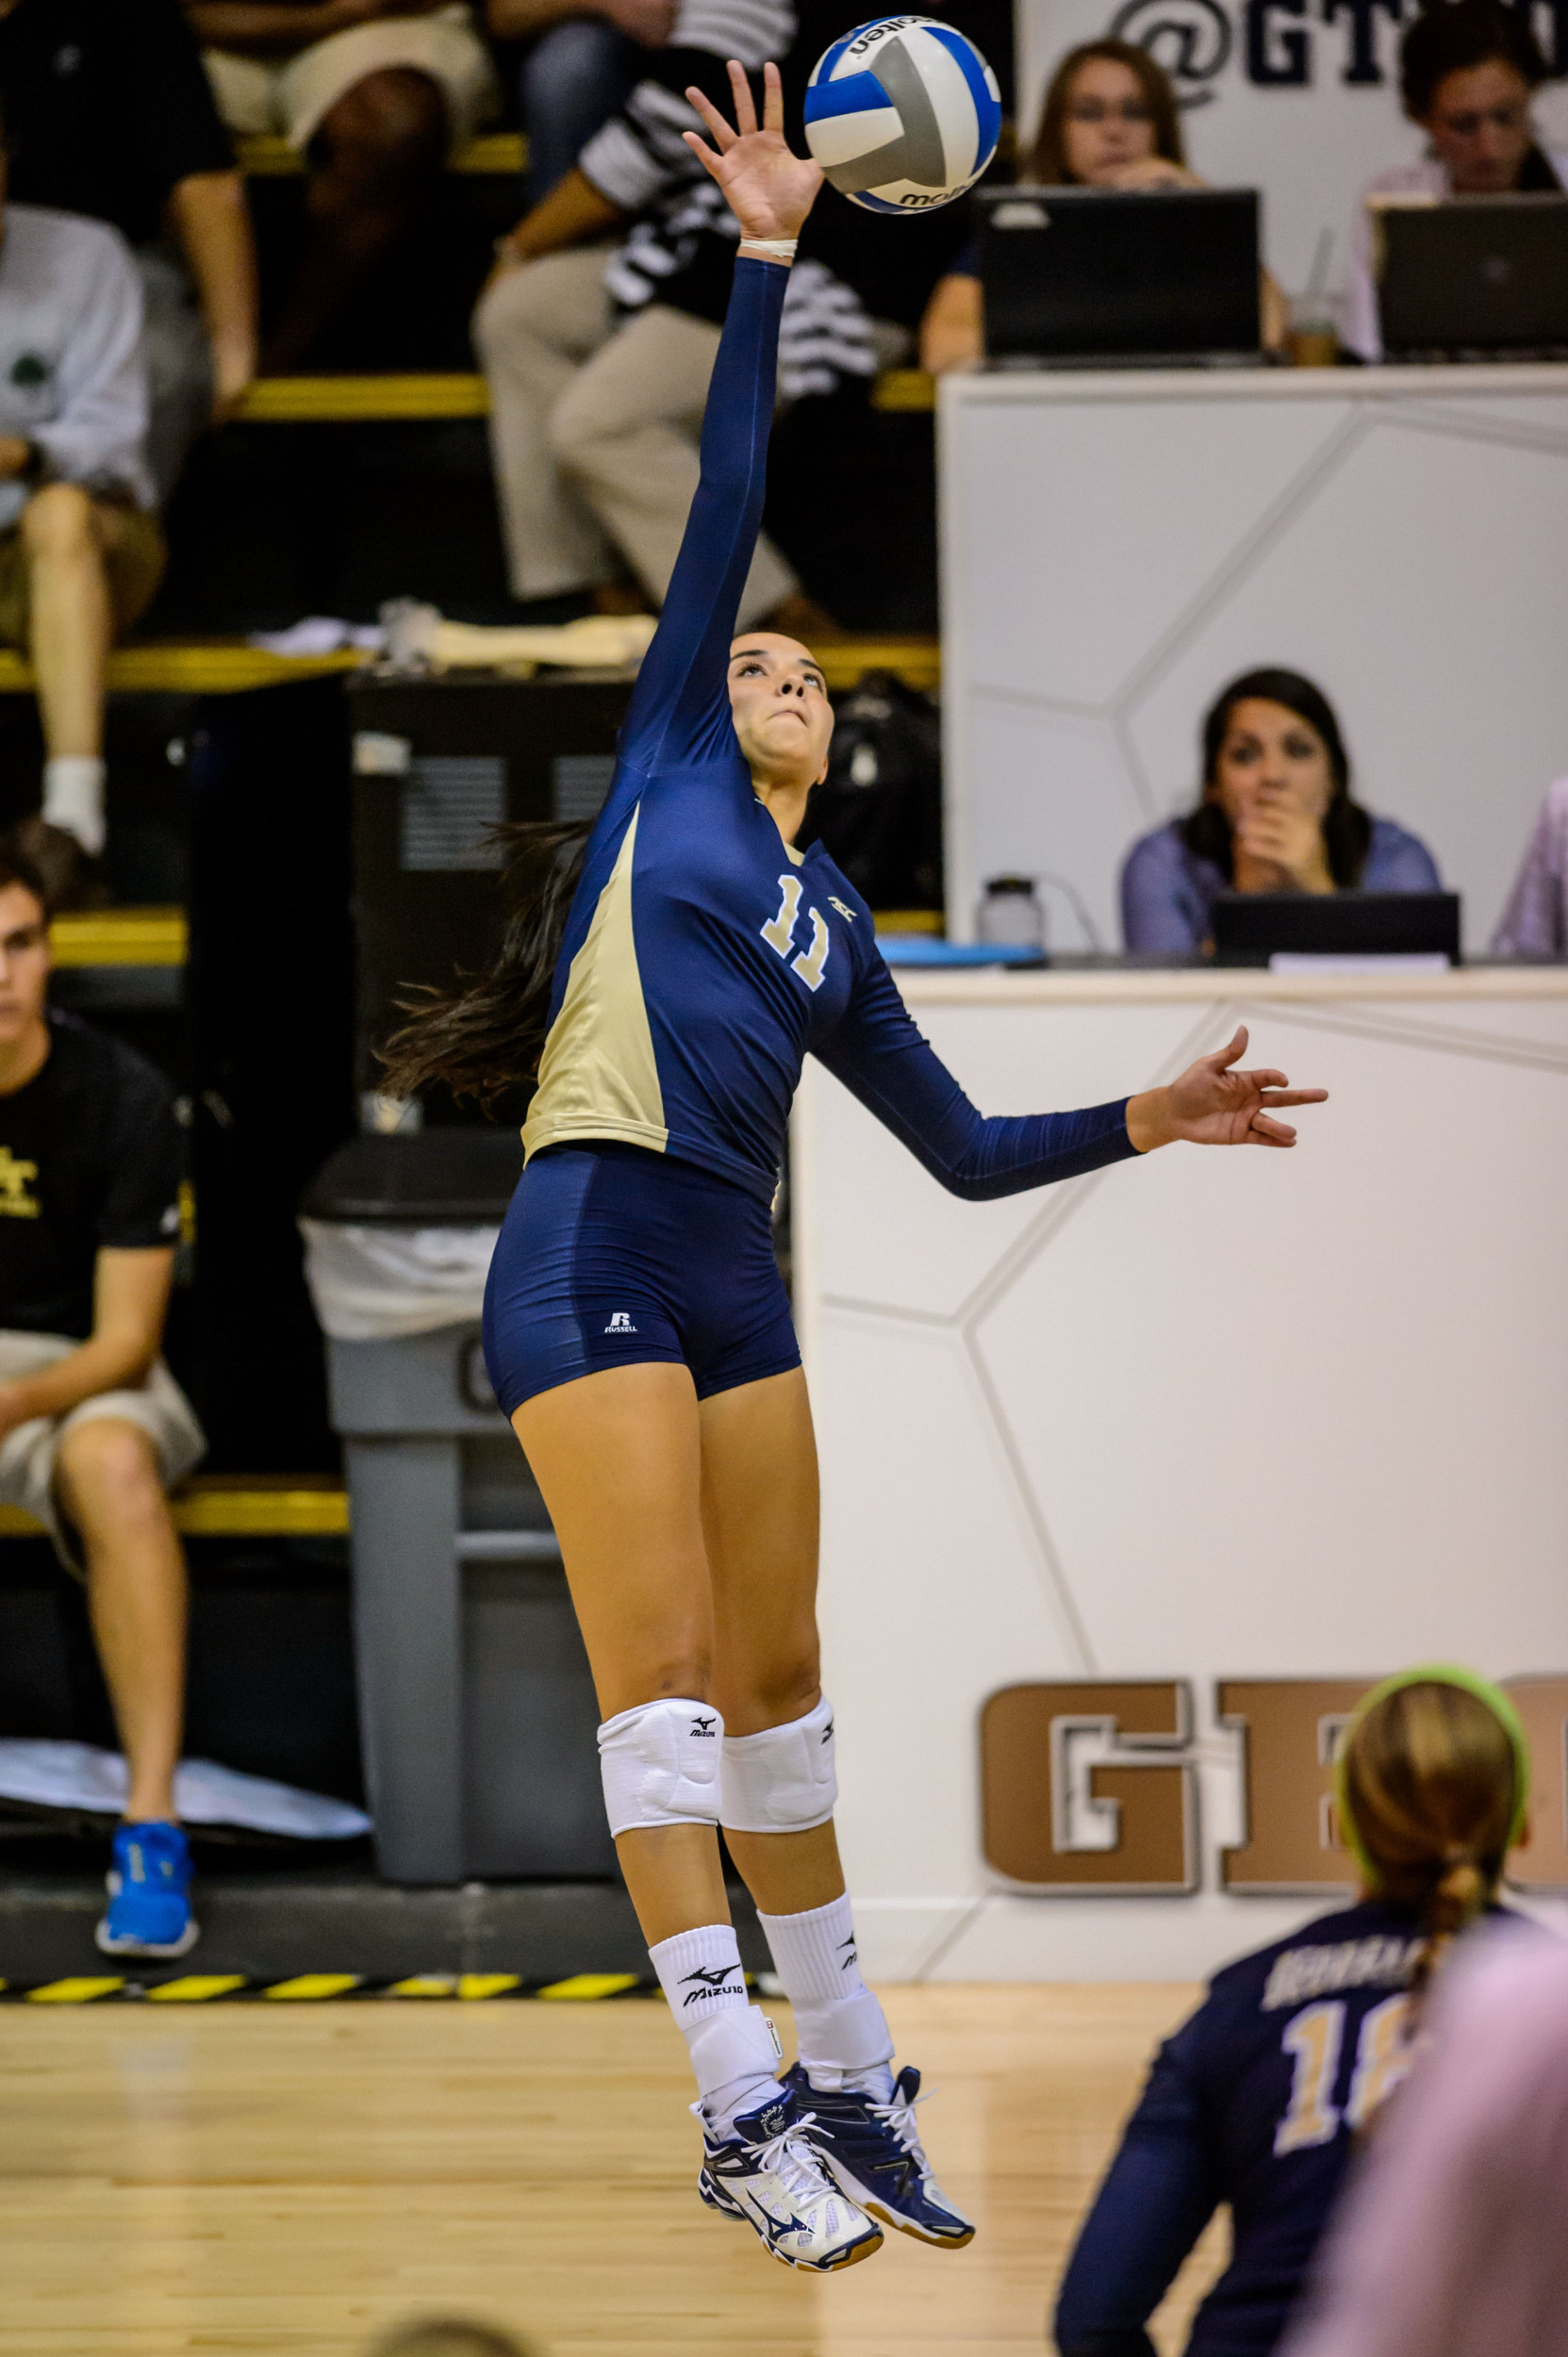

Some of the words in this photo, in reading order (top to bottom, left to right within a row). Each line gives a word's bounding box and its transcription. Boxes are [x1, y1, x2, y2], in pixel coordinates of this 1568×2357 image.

[850, 15, 937, 56] olten
[759, 874, 830, 993] 11
[603, 1326, 638, 1334] RUSSELL
